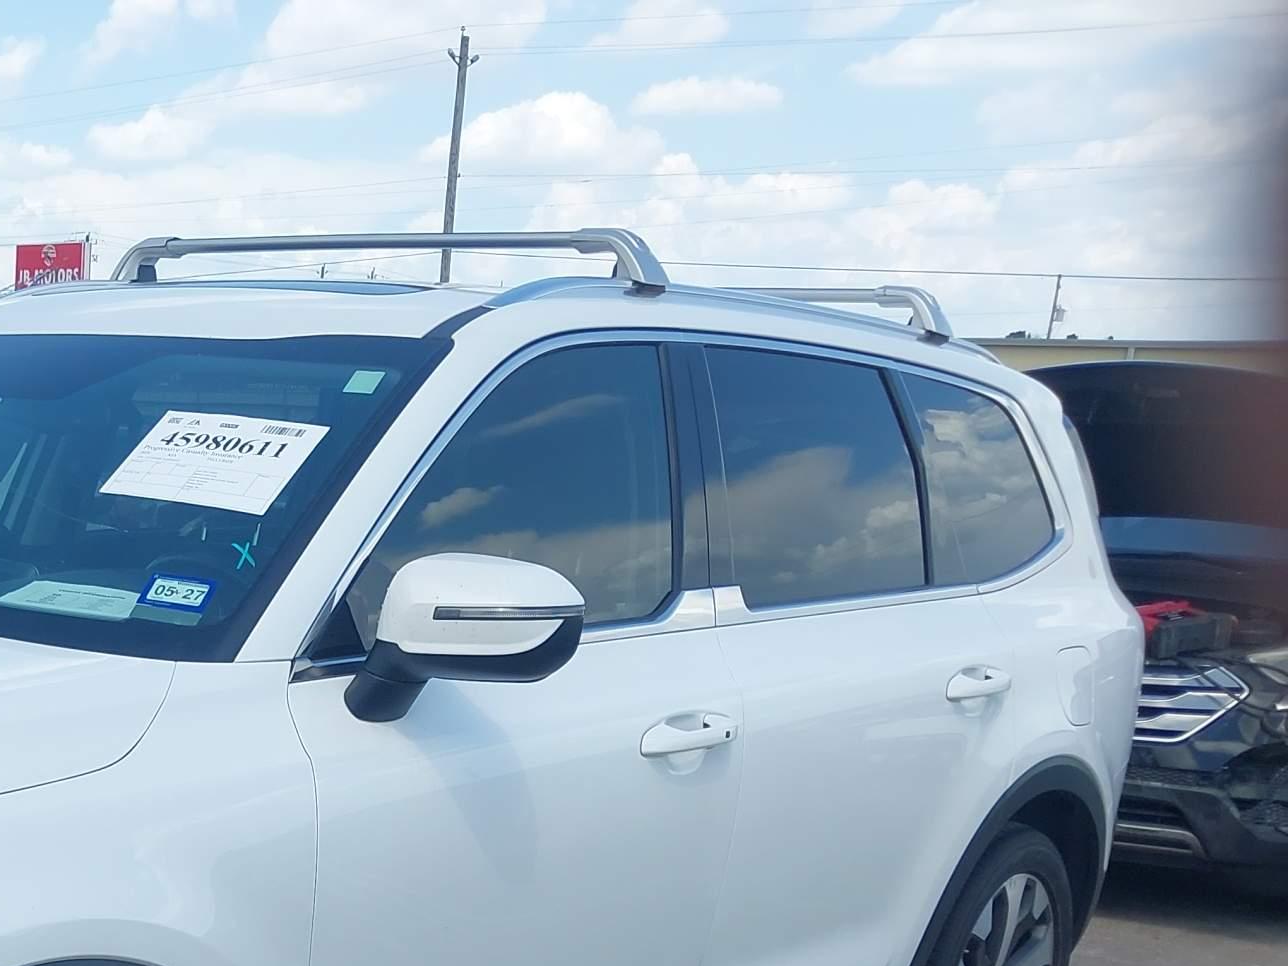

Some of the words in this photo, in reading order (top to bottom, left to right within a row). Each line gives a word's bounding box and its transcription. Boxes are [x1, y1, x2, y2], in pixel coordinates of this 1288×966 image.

[34, 268, 79, 284] MOTORS
[161, 431, 289, 458] 45980611
[154, 584, 177, 598] 05
[181, 587, 205, 601] 27
